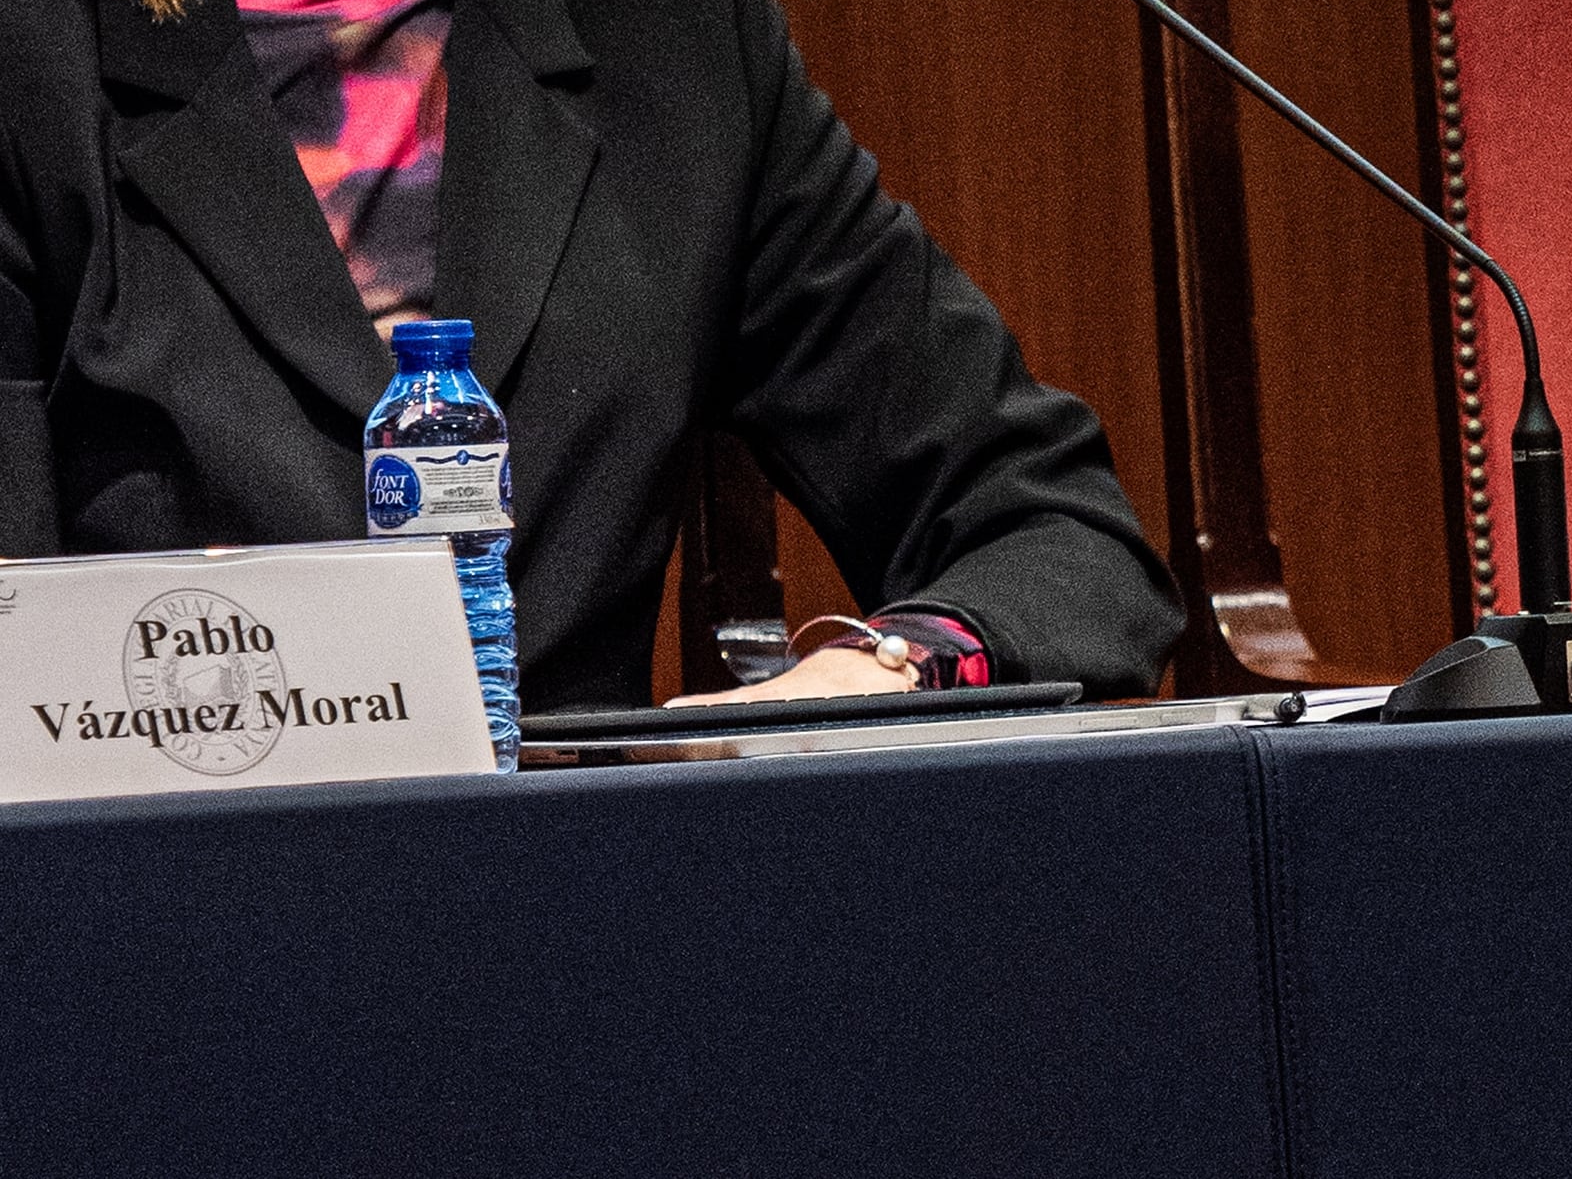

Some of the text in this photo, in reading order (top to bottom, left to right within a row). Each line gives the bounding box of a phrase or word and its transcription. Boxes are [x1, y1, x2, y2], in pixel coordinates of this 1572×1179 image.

[133, 615, 275, 661] Pablo
[30, 700, 246, 748] Vázquez
[255, 682, 410, 728] Moral
